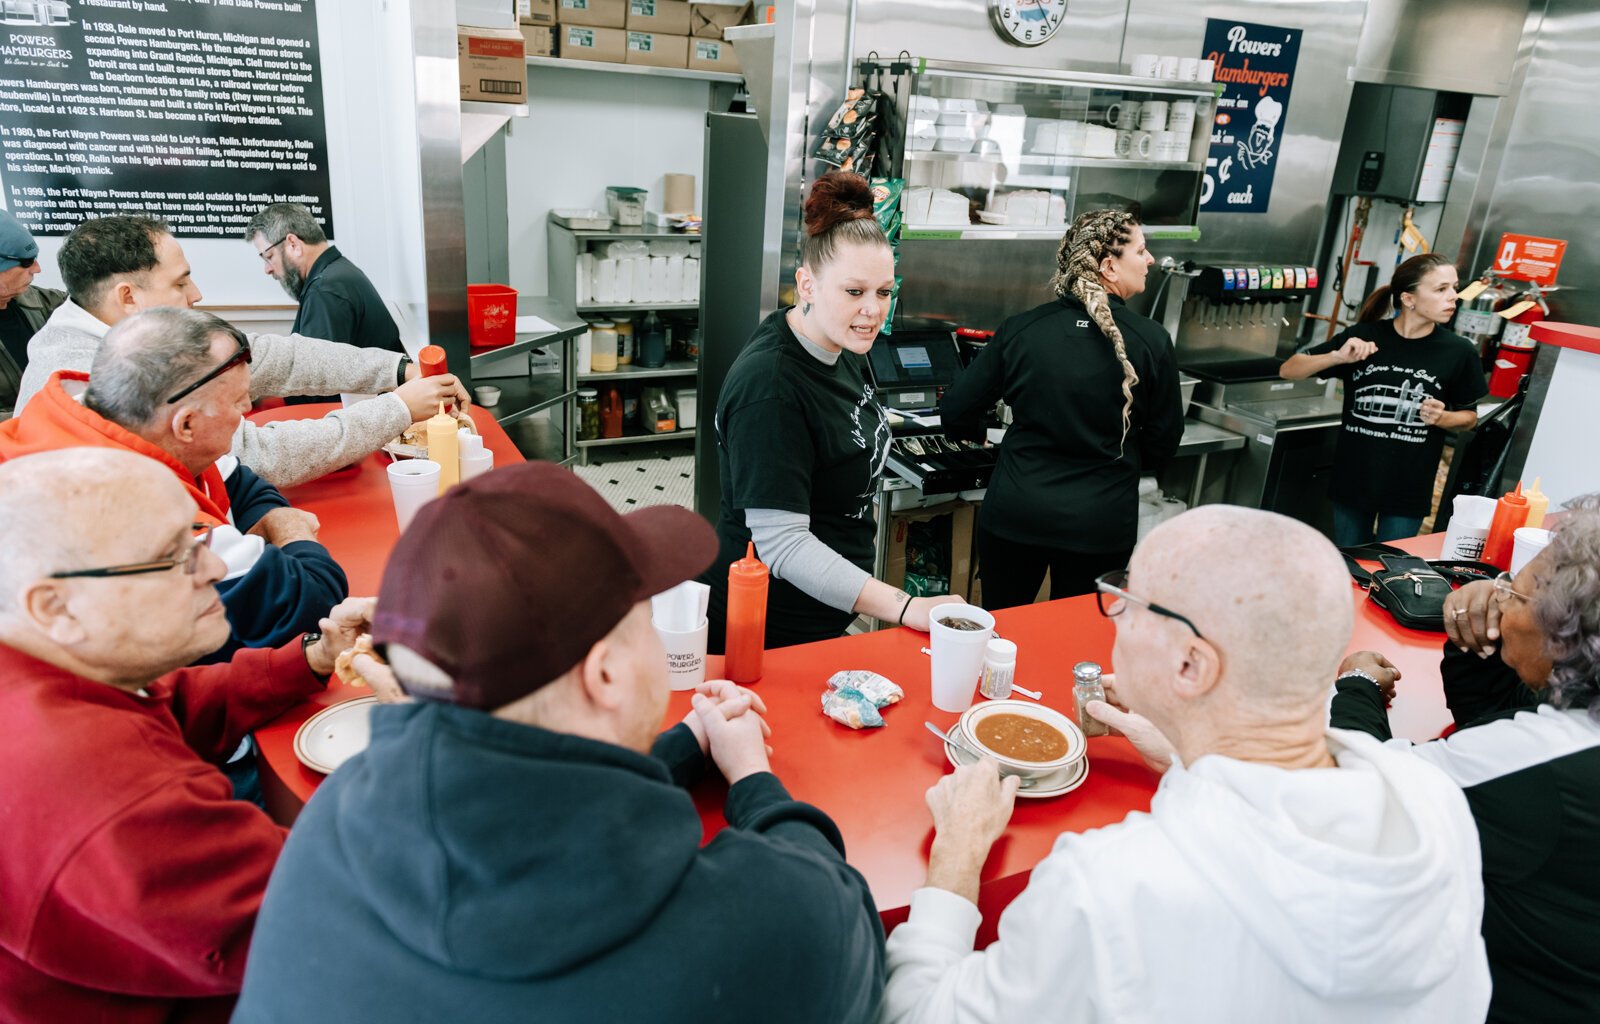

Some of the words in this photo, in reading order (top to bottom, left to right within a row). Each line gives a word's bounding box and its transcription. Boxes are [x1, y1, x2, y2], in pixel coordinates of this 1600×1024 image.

[144, 2, 168, 12] hand.
[254, 0, 283, 11] Powers
[284, 2, 302, 12] built
[1013, 22, 1019, 32] 7
[1051, 14, 1057, 24] 4
[93, 22, 117, 34] 1938,
[118, 24, 137, 34] Dale
[138, 27, 166, 36] moved
[177, 29, 195, 38] Port
[196, 30, 222, 42] Huron,
[223, 32, 259, 44] Michigan
[276, 38, 304, 47] opened
[1025, 30, 1032, 40] 6
[1041, 26, 1047, 35] 5
[9, 34, 56, 46] POWERS
[85, 35, 115, 44] second
[117, 36, 148, 47] Powers
[149, 39, 200, 52] Hamburgers.
[214, 44, 232, 53] then
[234, 46, 257, 55] added
[259, 49, 278, 57] more
[280, 49, 303, 59] stores
[87, 48, 130, 59] expanding
[132, 49, 148, 59] into
[150, 51, 174, 61] Grand
[176, 53, 206, 64] Rapids,
[207, 55, 244, 67] Michigan.
[246, 58, 263, 67] Clell
[264, 61, 289, 69] moved
[88, 59, 117, 69] Detroit
[156, 63, 175, 73] built
[176, 66, 205, 75] several
[207, 67, 231, 77] stores
[232, 69, 254, 78] there.
[256, 70, 281, 80] Harold
[282, 73, 313, 82] retained
[106, 72, 144, 82] Dearborn
[145, 74, 178, 85] location
[196, 78, 213, 88] Leo,
[221, 80, 251, 90] railroad
[252, 82, 279, 91] worker
[280, 83, 304, 93] before
[26, 79, 79, 92] Hamburgers
[100, 84, 122, 94] born,
[123, 86, 158, 95] returned
[184, 88, 209, 100] family
[210, 91, 230, 100] roots
[232, 92, 251, 102] (they
[273, 95, 296, 104] raised
[0, 90, 51, 103] teubenville)
[62, 94, 116, 104] northeastern
[118, 96, 149, 106] Indiana
[167, 100, 186, 108] built
[193, 101, 214, 110] store
[224, 103, 240, 112] Fort
[240, 104, 266, 114] Wayne
[276, 106, 297, 115] 1940.
[297, 107, 314, 116] This
[22, 103, 55, 113] located
[67, 106, 89, 115] 1402
[99, 108, 135, 117] Harrison
[136, 109, 148, 118] St.
[165, 111, 197, 121] become
[204, 113, 221, 122] Fort
[221, 114, 247, 124] Wayne
[248, 116, 282, 125] tradition.
[11, 128, 36, 138] 1980,
[52, 129, 70, 138] Fort
[70, 130, 99, 140] Wayne
[100, 131, 132, 141] Powers
[151, 134, 169, 142] sold
[179, 135, 201, 144] Leo's
[202, 137, 219, 146] son,
[219, 136, 242, 146] Rolin.
[242, 138, 294, 149] Unfortunately,
[294, 140, 314, 149] Rolin
[23, 140, 67, 150] diagnosed
[69, 142, 88, 150] with
[136, 145, 154, 153] with
[170, 146, 194, 155] health
[196, 147, 222, 158] failing,
[224, 148, 270, 158] relinquished
[5, 152, 54, 161] operations.
[65, 153, 88, 163] 1990,
[89, 154, 111, 163] Rolin
[112, 155, 128, 164] lost
[143, 156, 162, 166] fight
[163, 157, 181, 166] with
[240, 161, 274, 170] company
[292, 162, 308, 170] sold
[23, 164, 49, 174] sister,
[50, 164, 81, 175] Marilyn
[83, 166, 113, 175] Penick.
[22, 187, 46, 197] 1999,
[62, 188, 80, 197] Fort
[80, 189, 108, 198] Wayne
[109, 189, 140, 198] Powers
[140, 190, 166, 199] stores
[188, 192, 205, 200] sold
[206, 192, 234, 201] outside
[248, 193, 274, 203] family,
[288, 194, 319, 203] continue
[1227, 185, 1253, 204] each
[25, 200, 57, 208] operate
[58, 200, 77, 208] with
[118, 201, 144, 210] values
[145, 202, 162, 210] that
[163, 202, 182, 210] have
[183, 203, 205, 211] made
[206, 203, 234, 212] Powers
[242, 204, 257, 212] Fort
[16, 211, 42, 220] nearly
[52, 212, 85, 221] century.
[178, 225, 224, 234] surrounding
